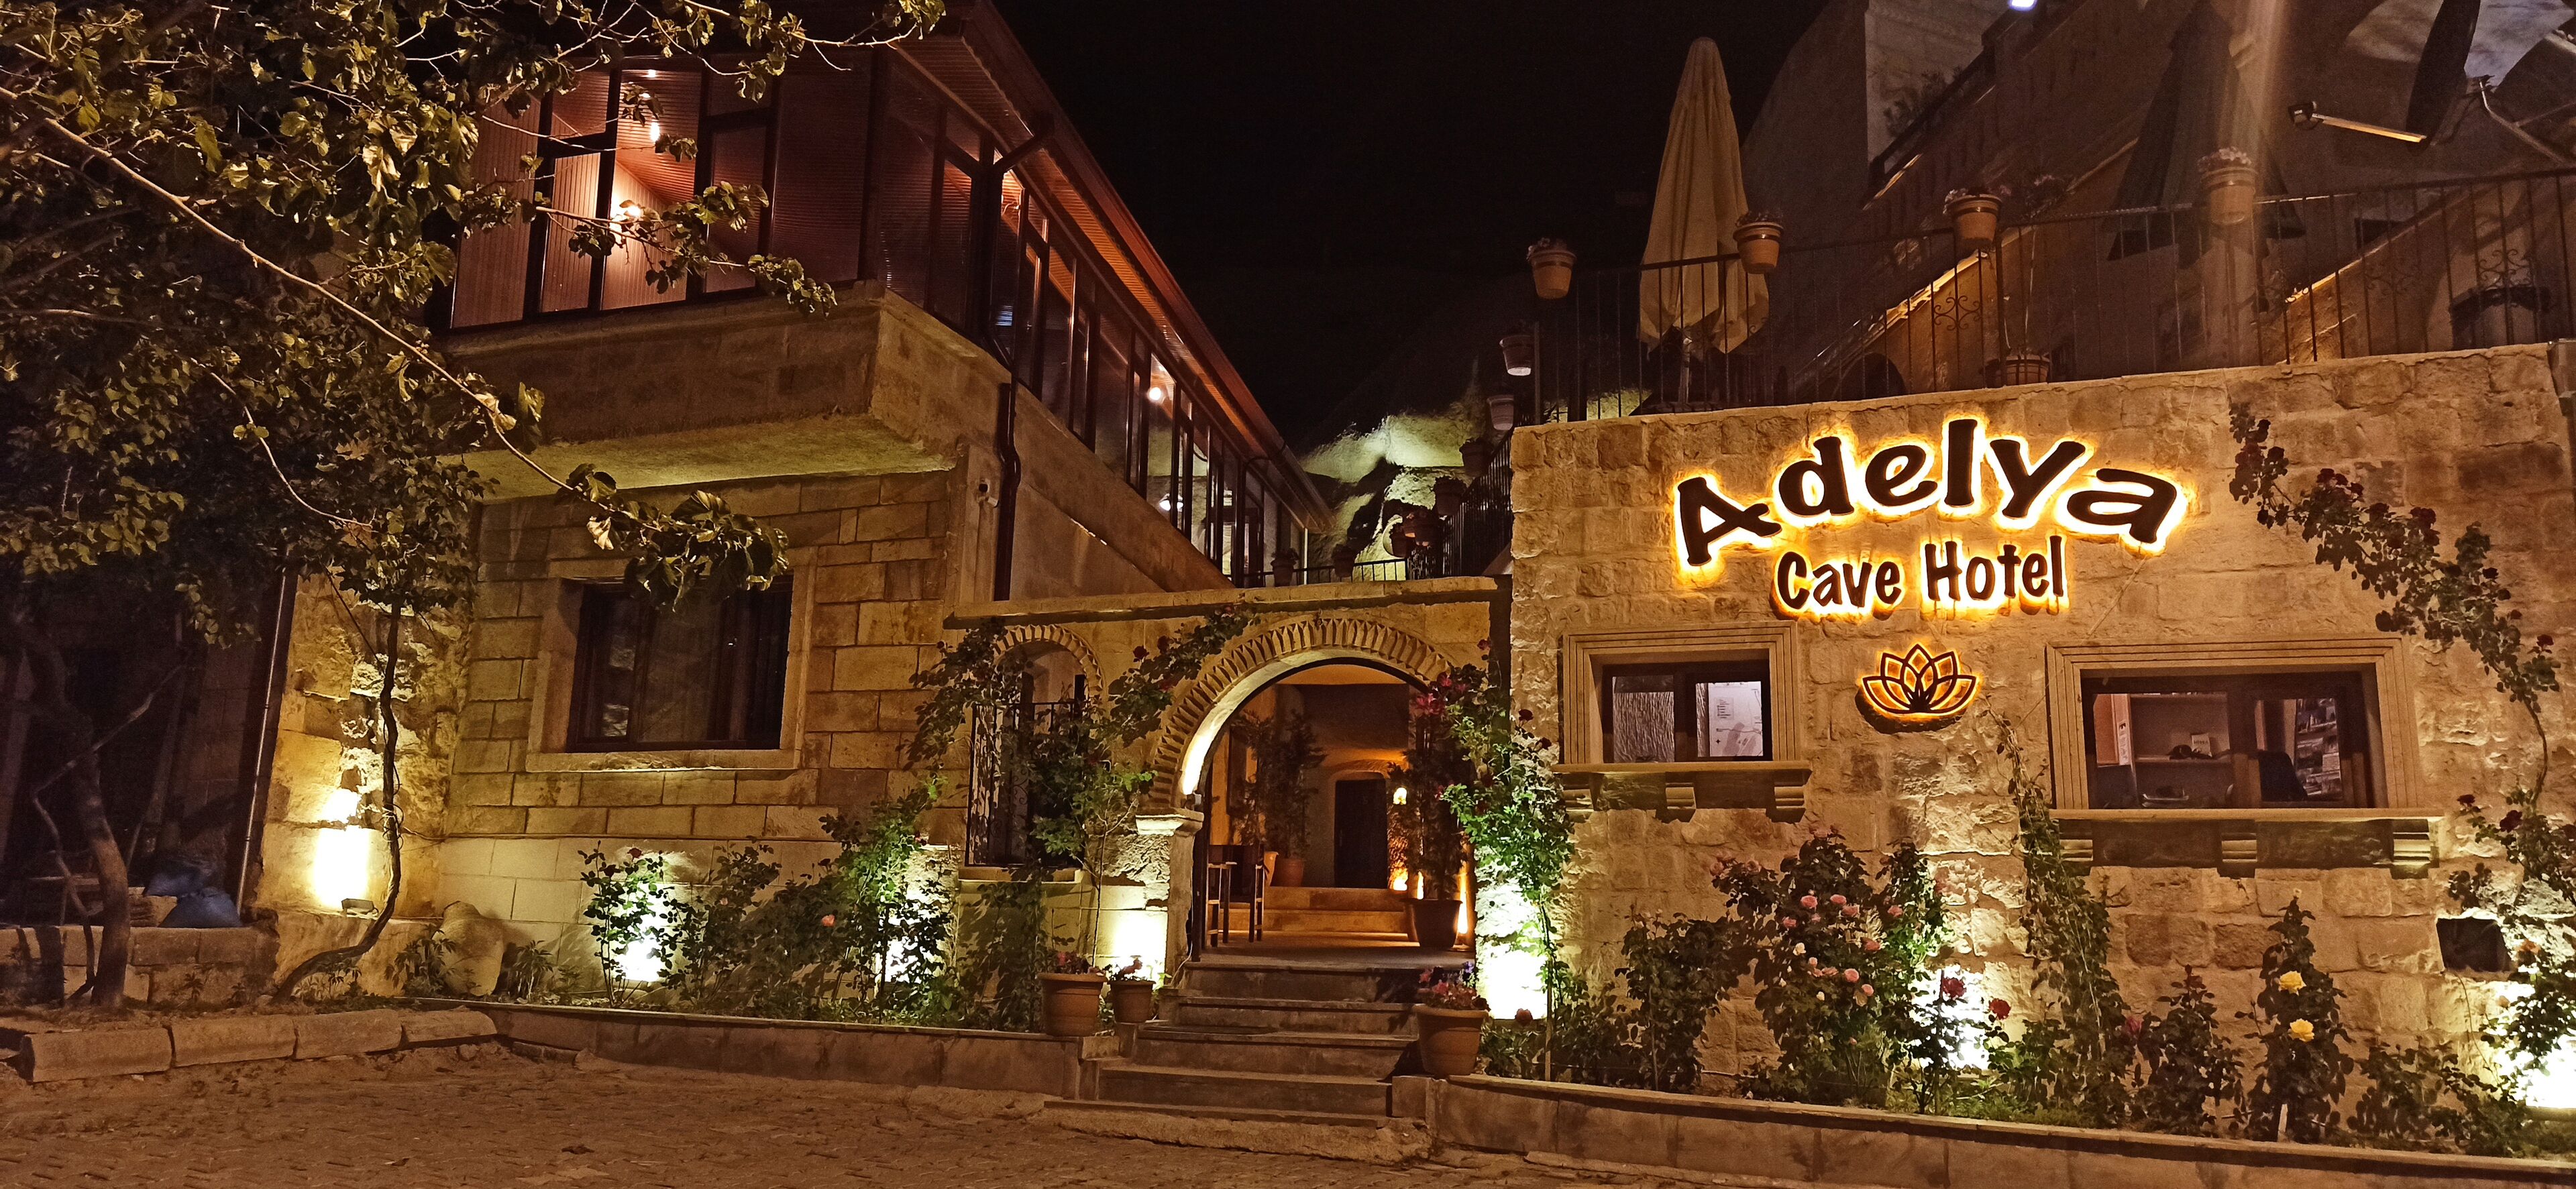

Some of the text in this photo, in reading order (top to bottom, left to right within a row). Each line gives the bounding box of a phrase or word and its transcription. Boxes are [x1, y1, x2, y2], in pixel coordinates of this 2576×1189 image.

[1677, 418, 2177, 566] Adelya
[1777, 535, 2064, 610] Cave Hotel
